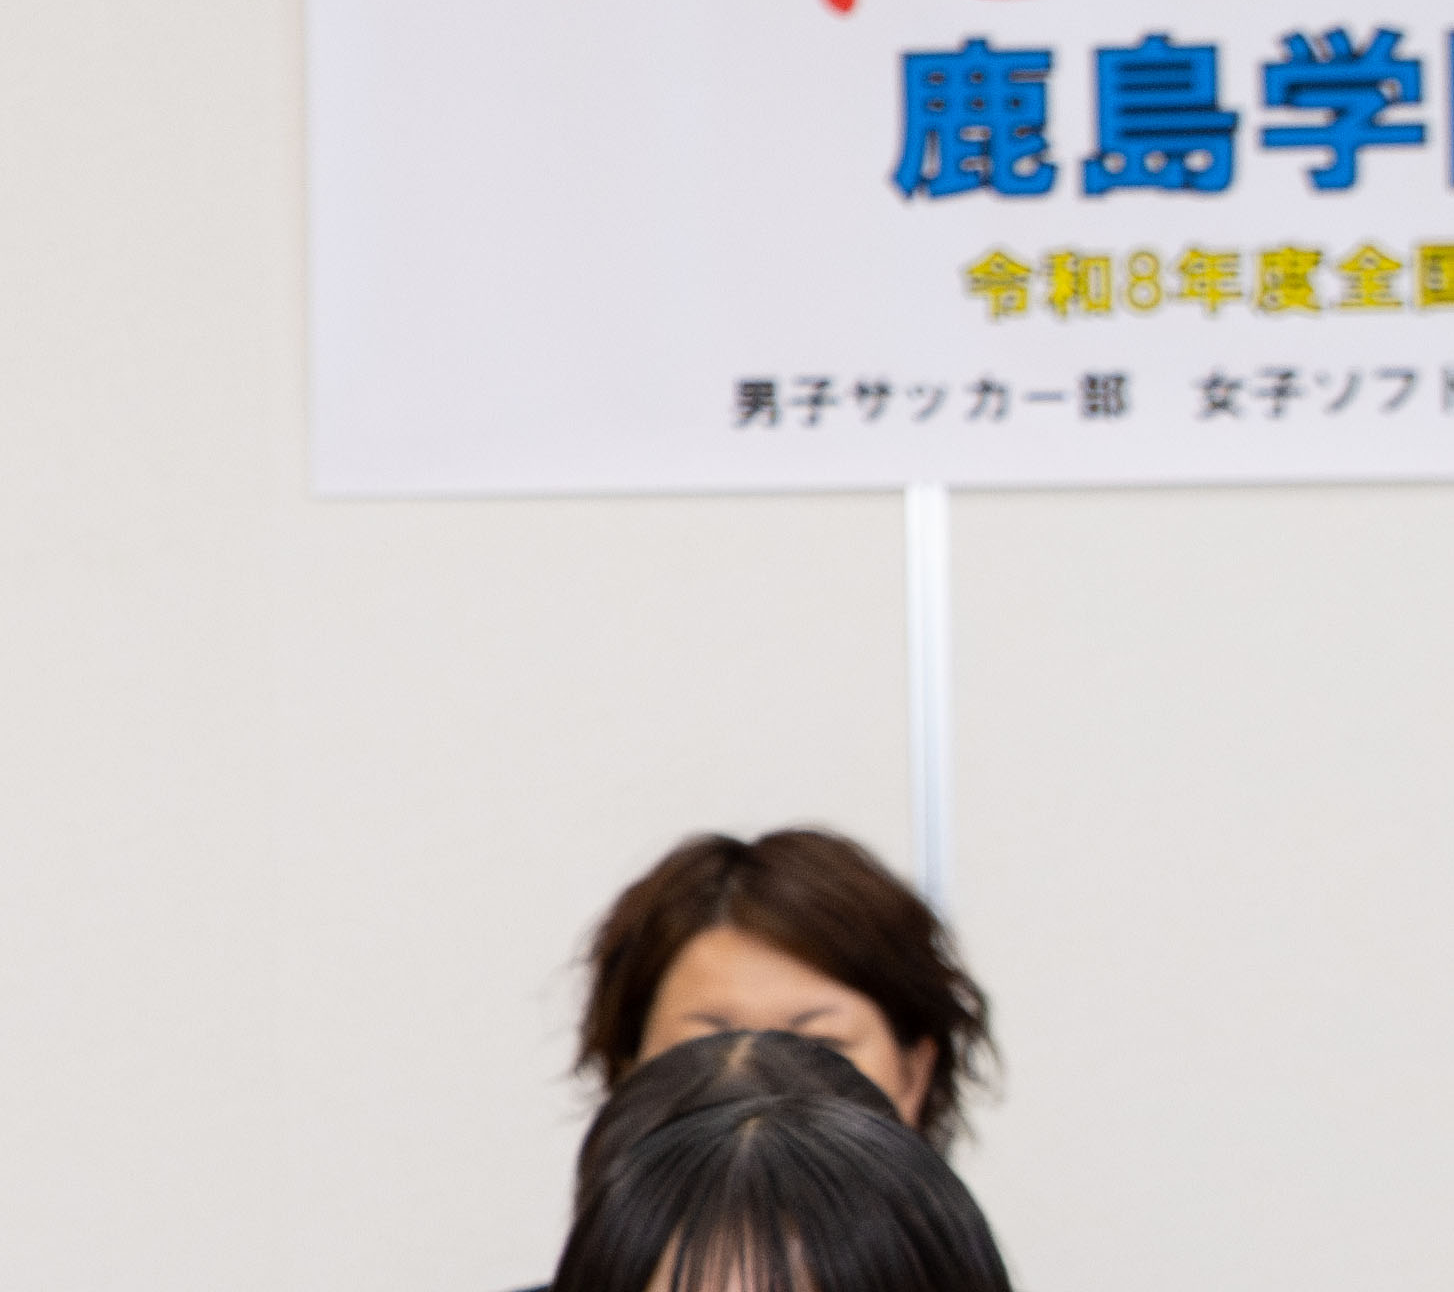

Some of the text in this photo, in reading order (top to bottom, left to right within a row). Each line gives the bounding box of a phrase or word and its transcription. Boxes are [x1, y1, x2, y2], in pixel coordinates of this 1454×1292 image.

[890, 26, 1454, 200] 鹿島学
[734, 370, 1128, 428] 男子サッカー部
